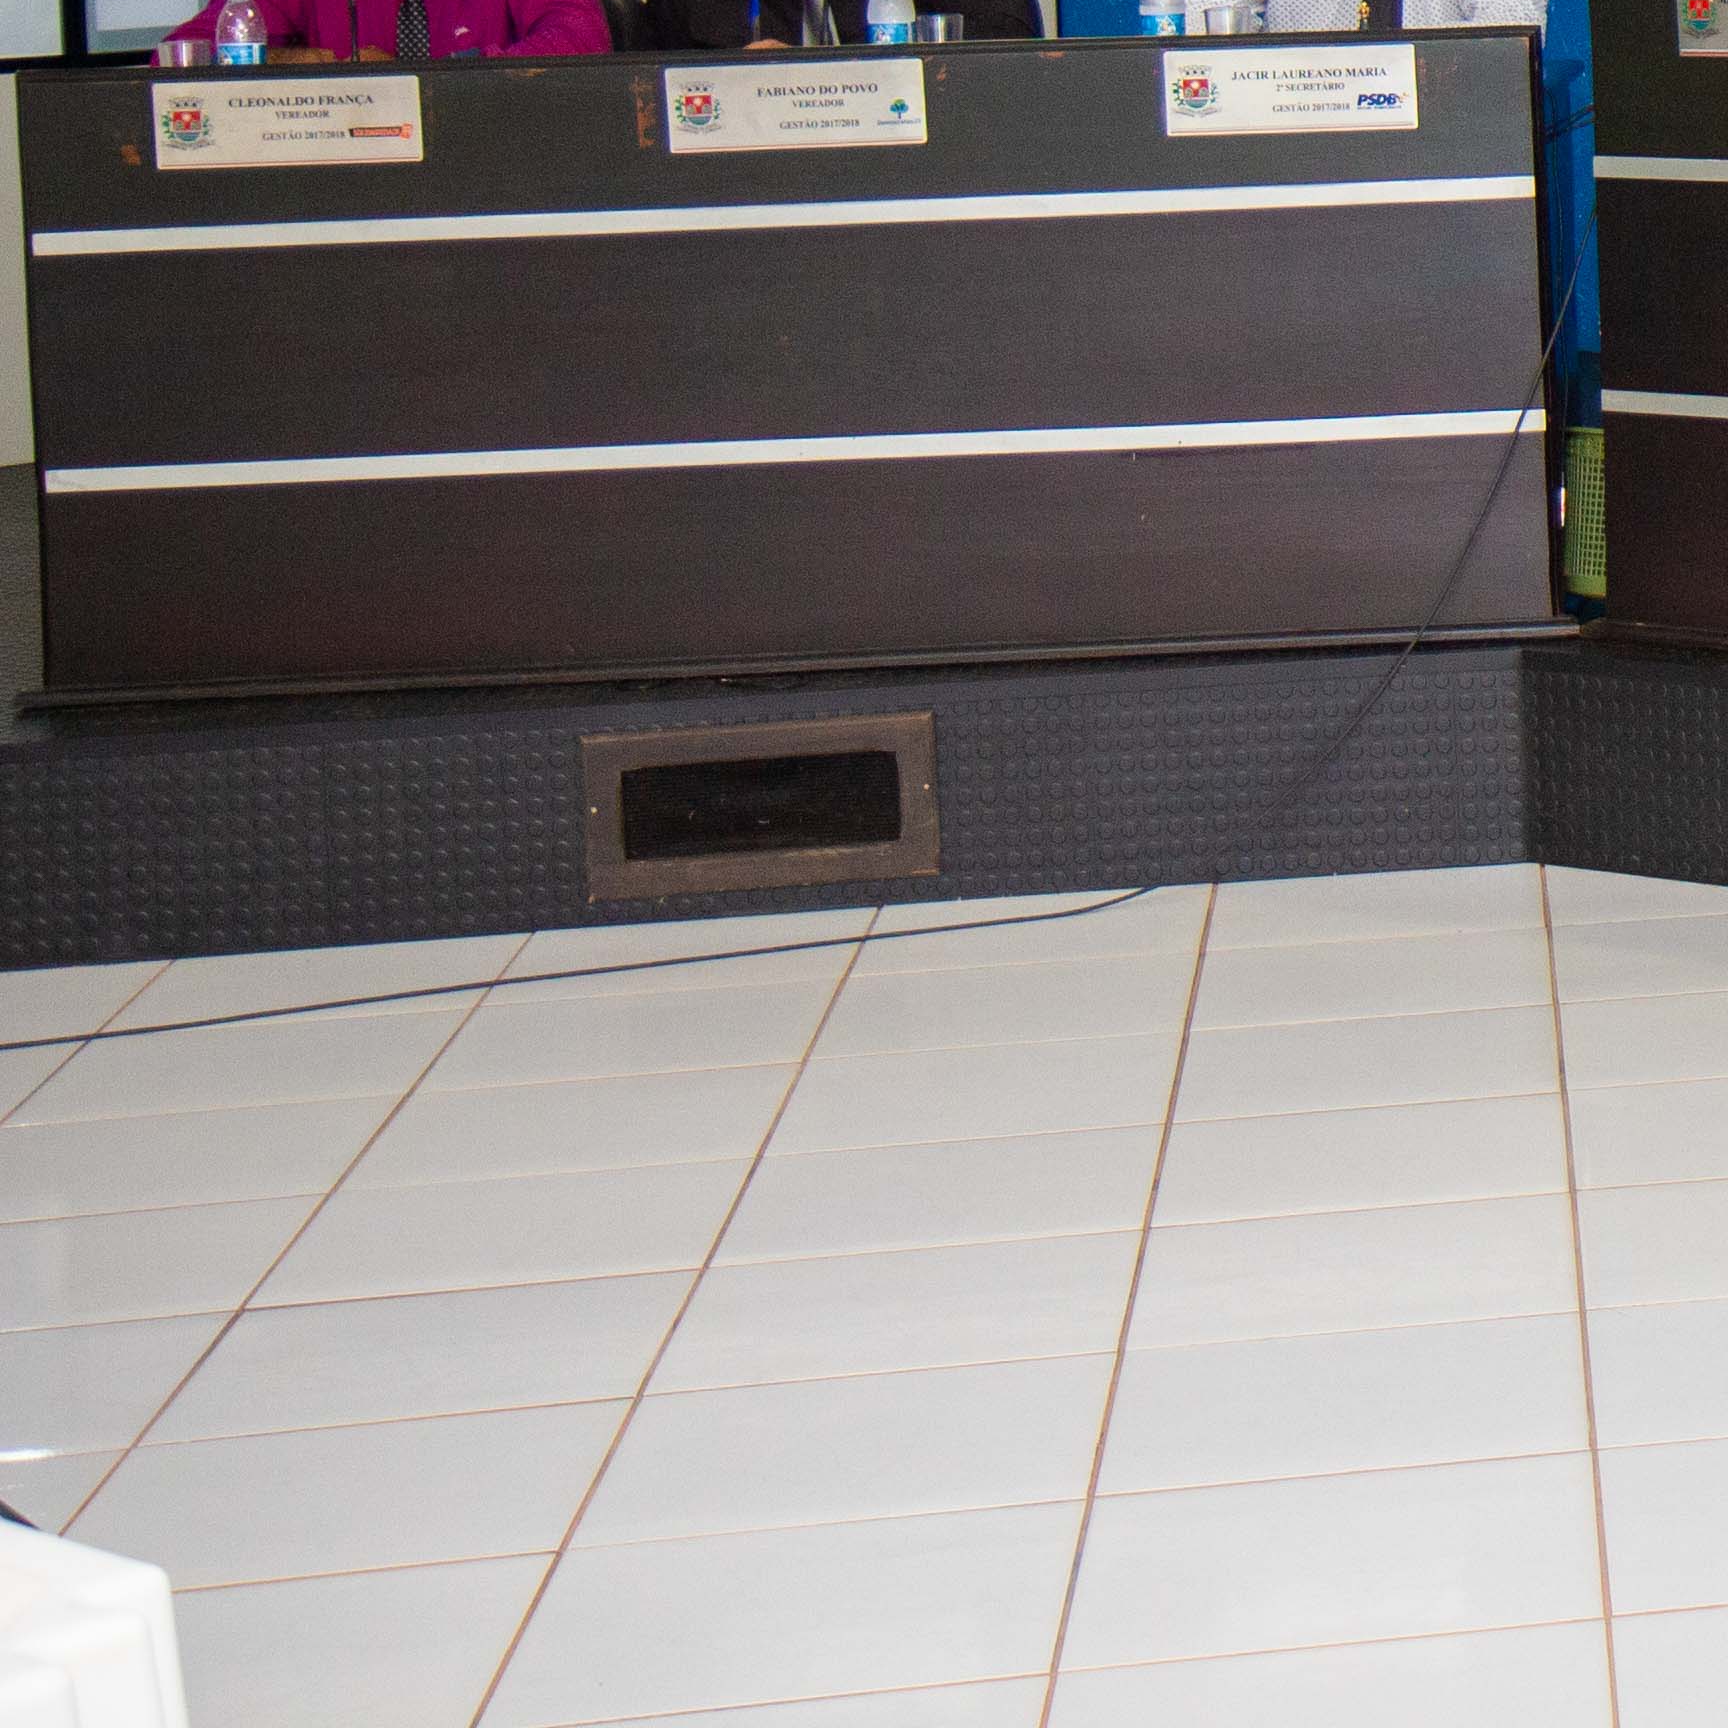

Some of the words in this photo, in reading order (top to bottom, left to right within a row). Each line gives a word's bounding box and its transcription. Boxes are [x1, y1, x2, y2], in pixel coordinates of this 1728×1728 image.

[1231, 69, 1268, 81] JACIR
[1272, 68, 1342, 80] LAUREANO
[1345, 67, 1387, 78] MARIA
[756, 86, 815, 98] FABIANO
[819, 84, 838, 95] DO
[841, 83, 878, 94] POVO
[1285, 80, 1345, 92] SECRETÁRIO
[228, 95, 316, 108] CLEONALDO
[318, 93, 374, 106] FRANÇA
[792, 99, 844, 108] VEREADOR
[1357, 93, 1398, 106] PSDB
[1272, 101, 1310, 113] GESTÃO
[1312, 102, 1351, 112] 2017/2018
[275, 109, 330, 119] VEREADOR
[779, 118, 818, 130] GESTÃO
[819, 118, 860, 129] 2017/2018
[262, 129, 302, 141] GESTÃO
[304, 129, 345, 140] 2017/2018
